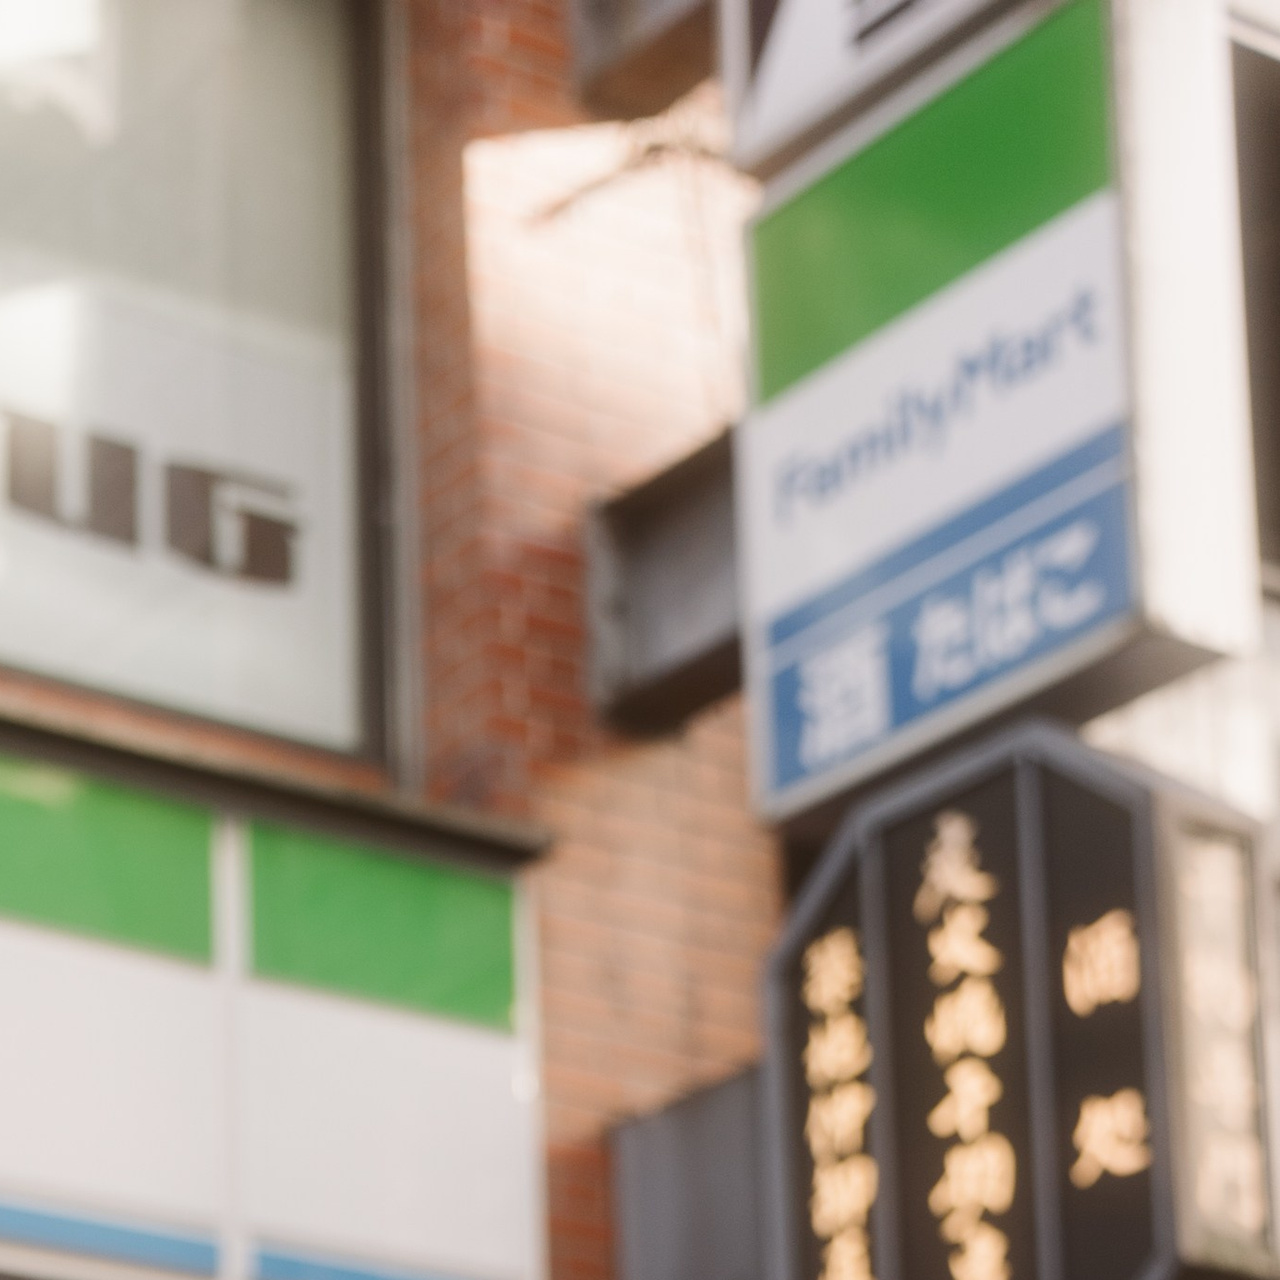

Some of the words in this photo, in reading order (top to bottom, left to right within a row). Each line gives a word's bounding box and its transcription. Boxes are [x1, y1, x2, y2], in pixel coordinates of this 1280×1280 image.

[772, 285, 1098, 525] FamilyMart
[910, 516, 1108, 702] たばこ
